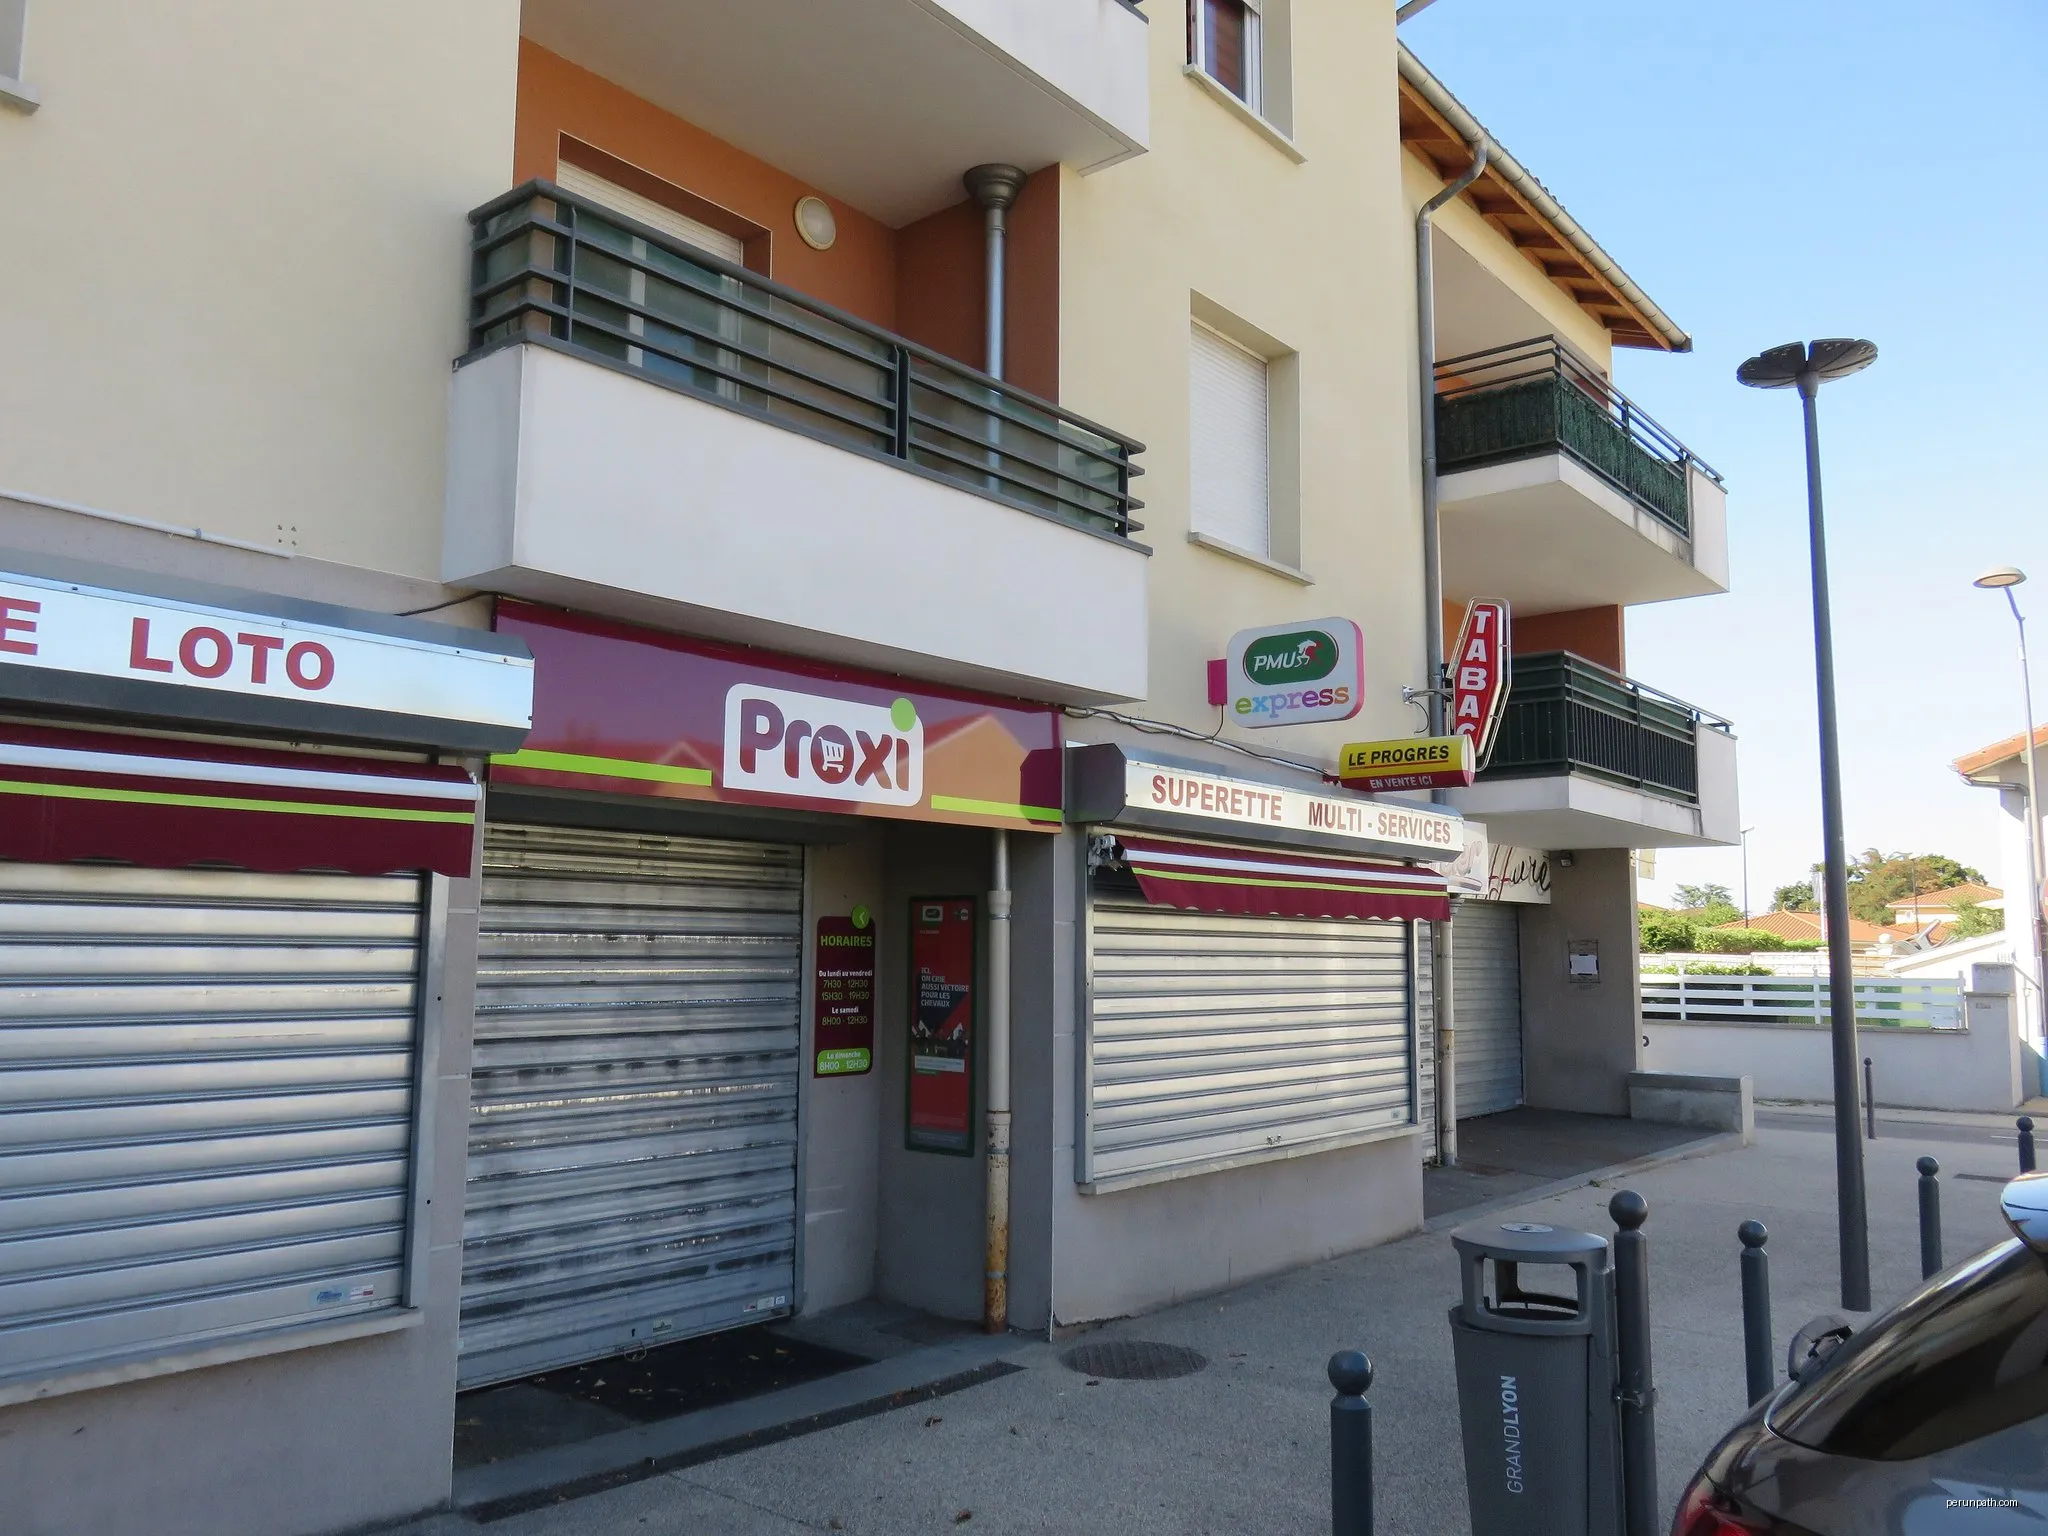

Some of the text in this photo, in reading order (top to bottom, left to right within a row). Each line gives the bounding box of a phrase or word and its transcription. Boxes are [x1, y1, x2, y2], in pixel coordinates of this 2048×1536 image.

[130, 617, 335, 690] LOTO
[1253, 651, 1297, 672] PMU
[1235, 687, 1350, 718] express
[1349, 752, 1366, 766] LE
[1370, 775, 1433, 789] EN VENTE ICI
[1152, 775, 1282, 821] SUPERETTE
[1308, 801, 1362, 832] MULTI
[1377, 812, 1451, 844] SERVICES
[820, 935, 873, 947] HORAIRES
[823, 979, 841, 988] 7H30
[847, 979, 868, 988] 12H30
[921, 983, 970, 992] AUSSI VICTOIRE
[821, 991, 843, 1001] 15H30
[849, 991, 869, 1000] 19H30
[920, 999, 950, 1007] CHEVAUX
[839, 1006, 859, 1014] samedi
[822, 1016, 841, 1026] 8H00
[847, 1015, 868, 1025] 12H30
[819, 1061, 840, 1072] 8H00
[846, 1059, 868, 1069] 12H30
